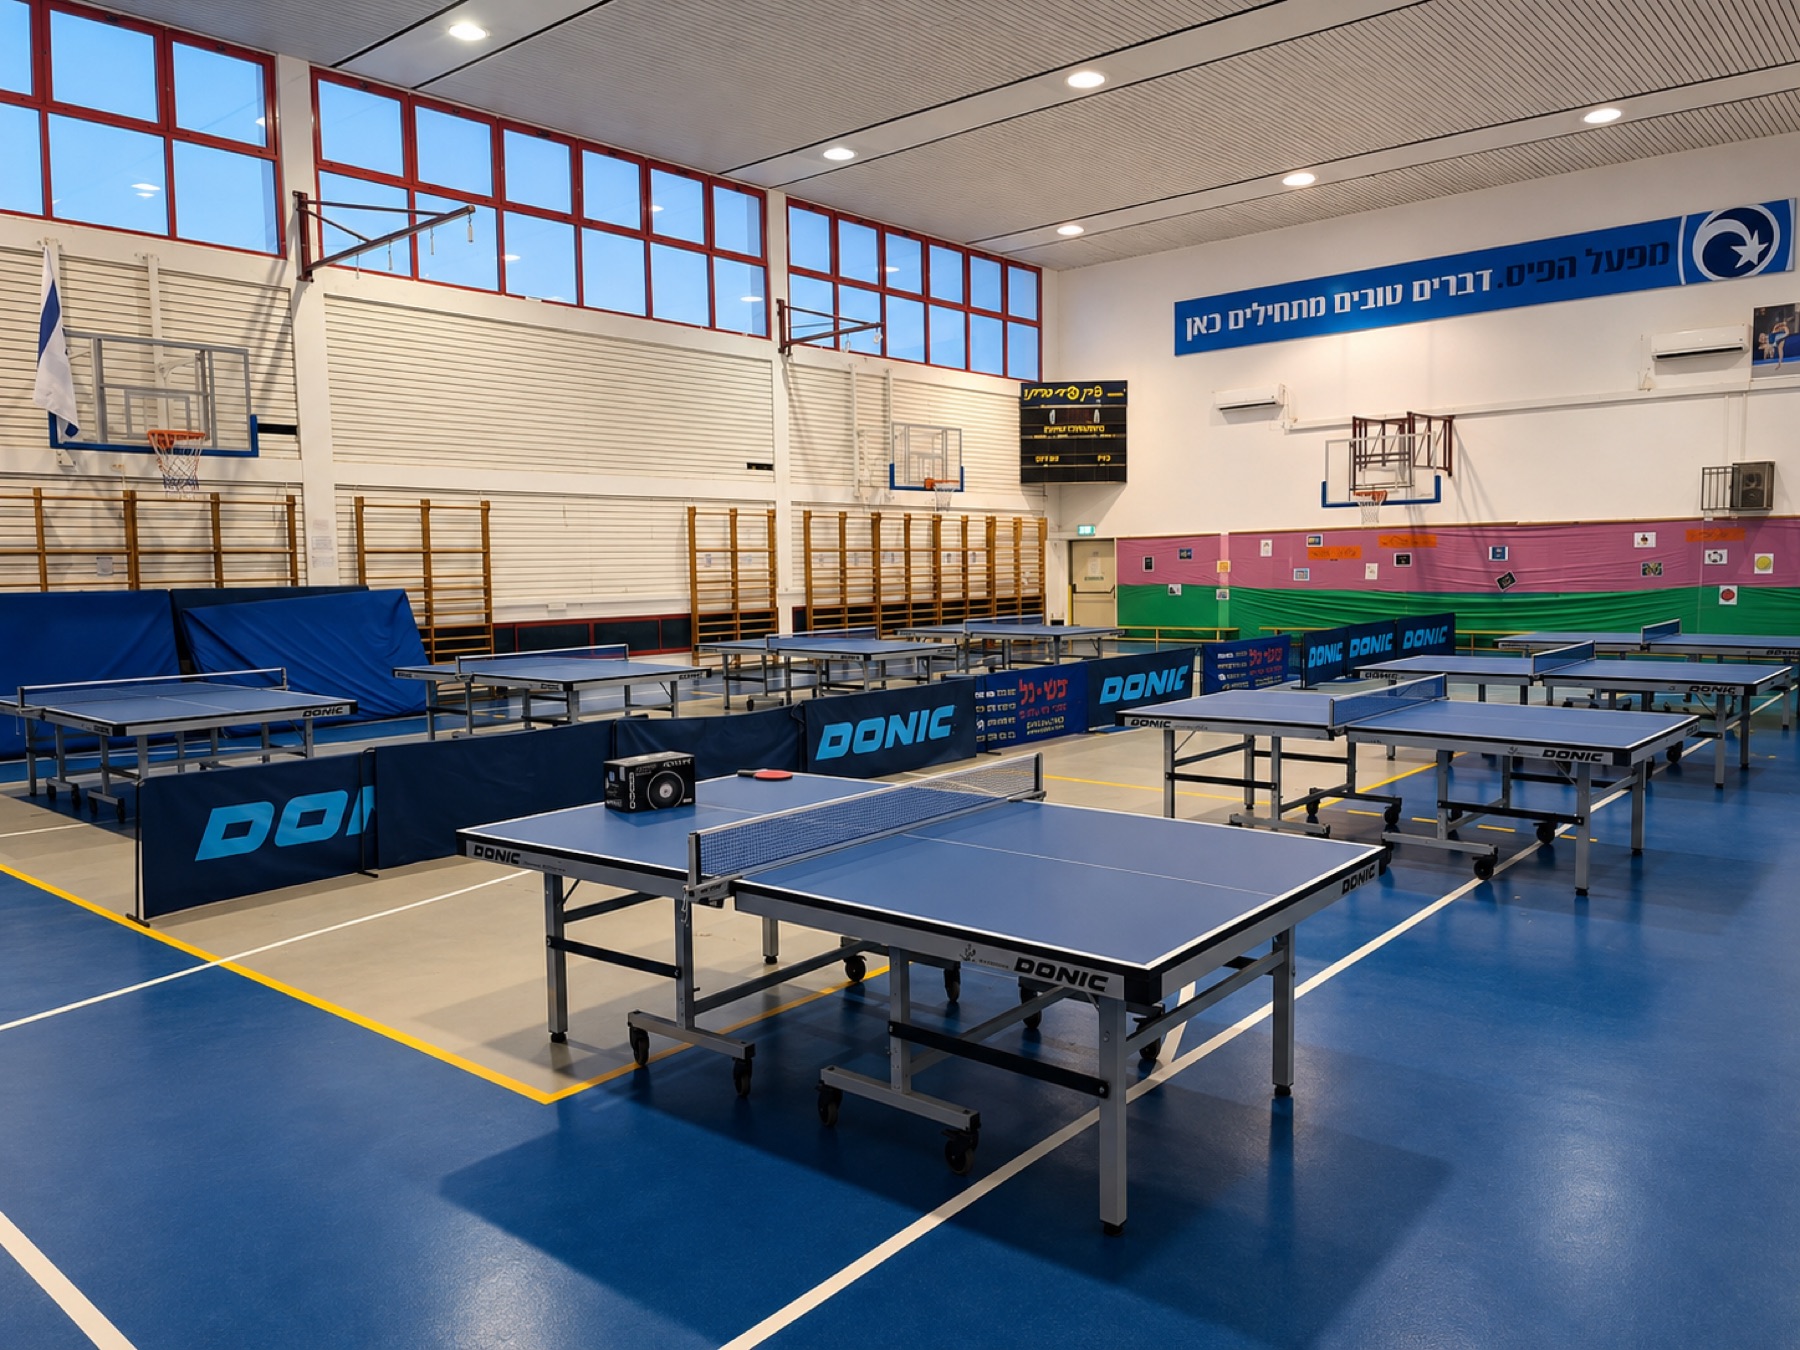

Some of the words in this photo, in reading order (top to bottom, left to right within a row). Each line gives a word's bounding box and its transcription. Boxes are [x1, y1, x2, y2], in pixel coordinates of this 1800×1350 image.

[1585, 241, 1669, 275] מפעל
[1334, 282, 1402, 315] טובים
[1412, 269, 1493, 302] דברים
[1185, 312, 1222, 342] כאן
[1228, 296, 1326, 331] מתחילים
[1350, 633, 1393, 659] DONIC
[1402, 625, 1448, 650] DONIC
[1308, 641, 1344, 668] DONIC
[1099, 665, 1189, 705] DONIC
[302, 706, 344, 717] DONIC
[1130, 718, 1172, 728] DONIC
[815, 704, 956, 761] DONIC
[1542, 748, 1605, 763] DONIC
[474, 844, 522, 865] DONIC
[1341, 863, 1376, 895] DONIC
[1014, 956, 1109, 993] DONIC
